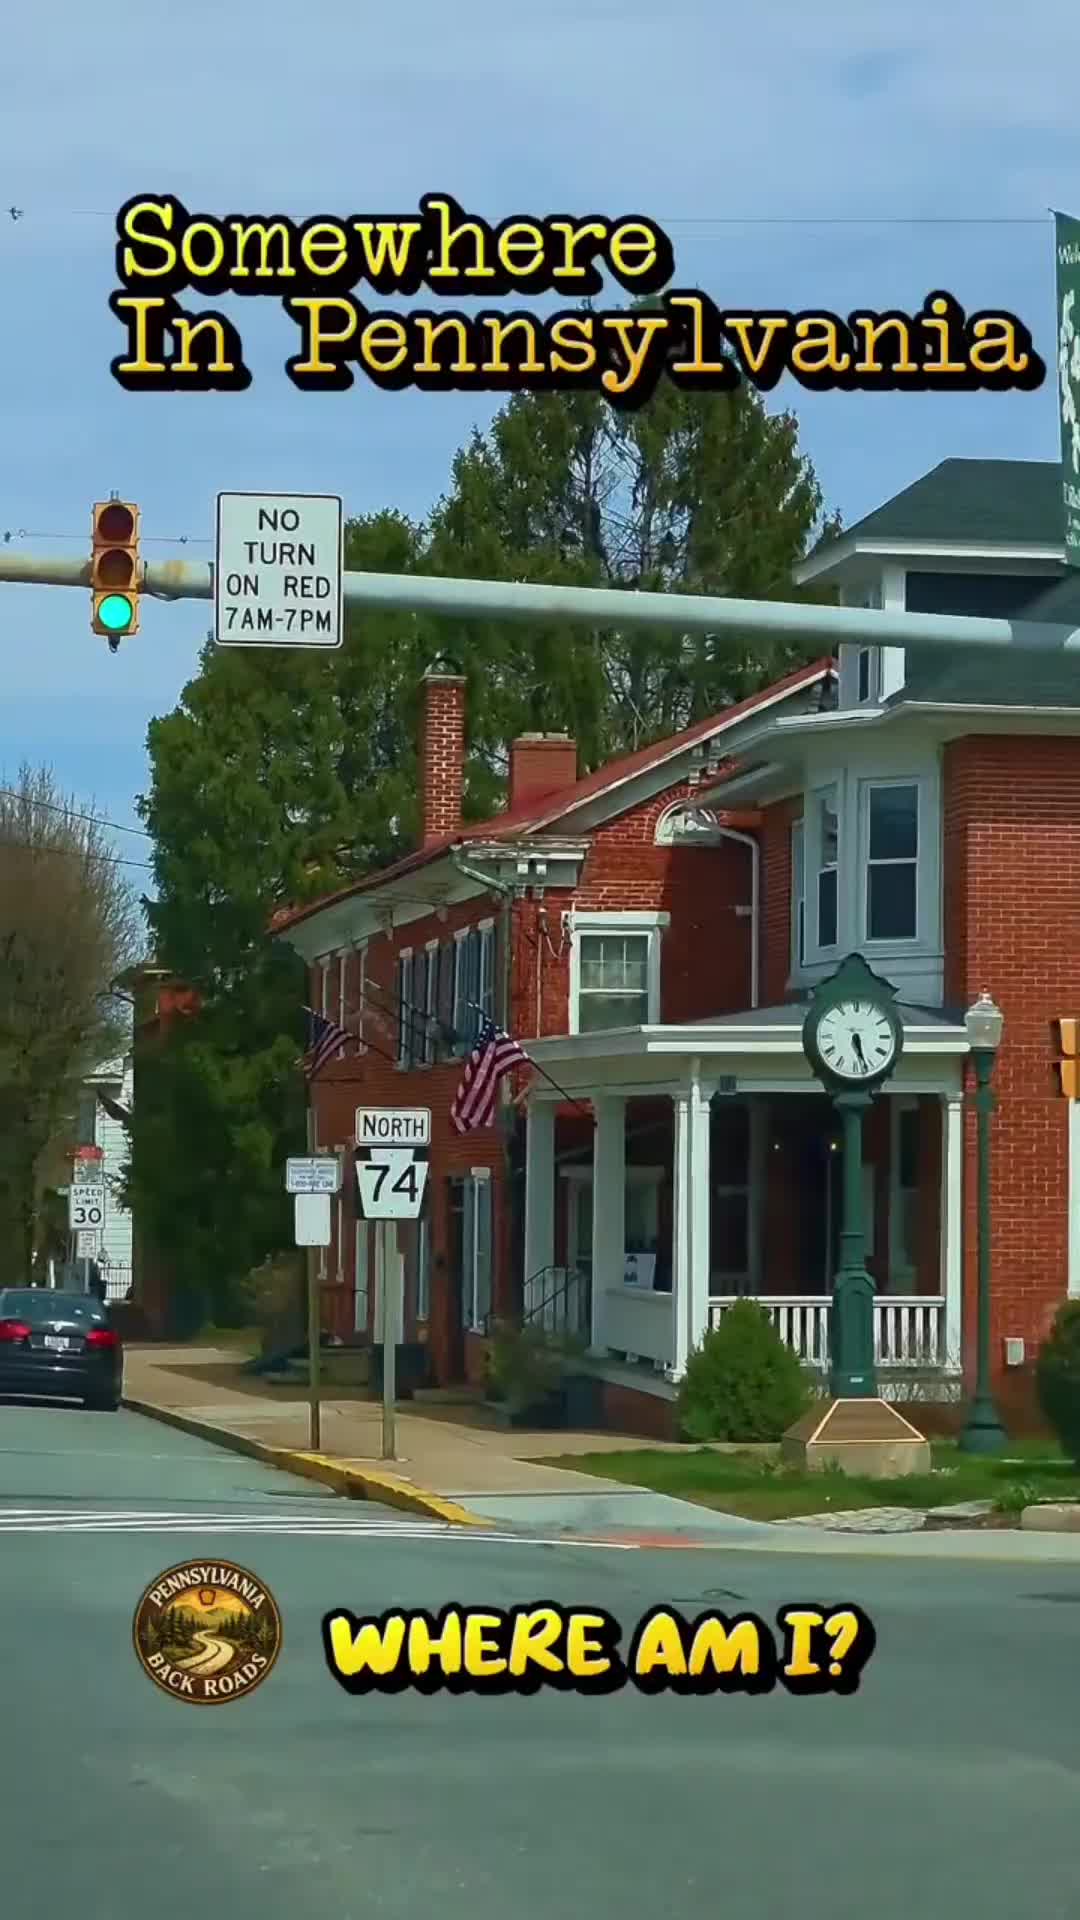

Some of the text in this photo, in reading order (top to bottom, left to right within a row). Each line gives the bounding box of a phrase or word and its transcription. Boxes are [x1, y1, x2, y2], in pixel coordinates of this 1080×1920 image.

[258, 508, 300, 532] NO
[243, 541, 315, 566] TURN
[226, 574, 331, 599] ON RED
[225, 607, 331, 633] 7AM-7PM
[363, 1114, 424, 1138] NORTH
[73, 1187, 102, 1197] SPEED
[364, 1164, 419, 1203] 74
[74, 1207, 101, 1224] 30
